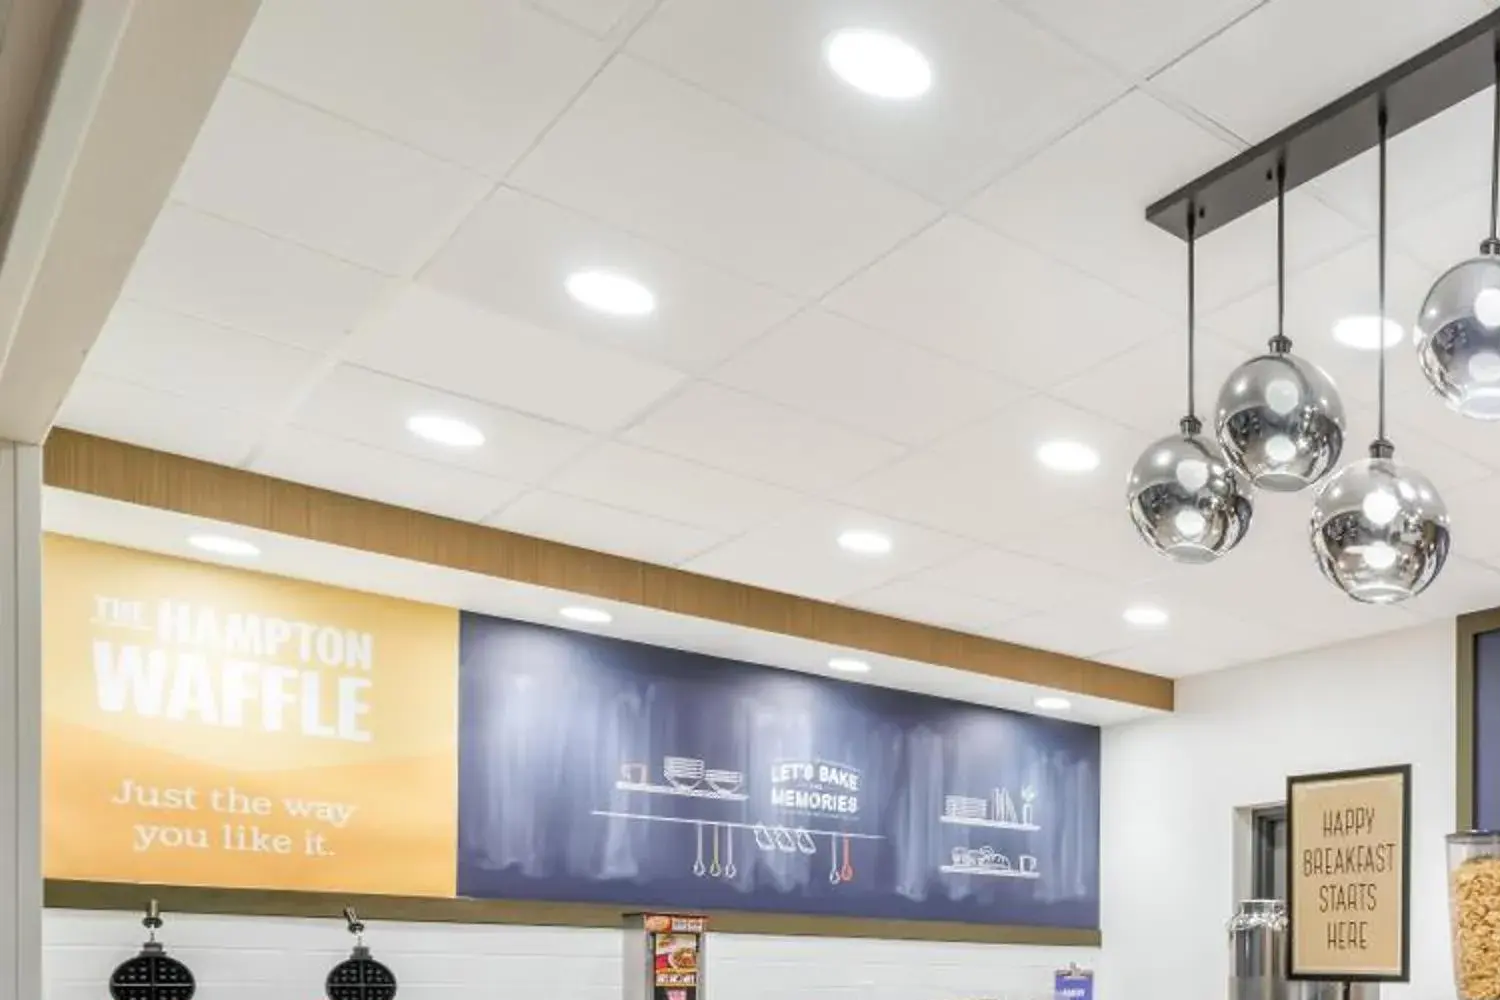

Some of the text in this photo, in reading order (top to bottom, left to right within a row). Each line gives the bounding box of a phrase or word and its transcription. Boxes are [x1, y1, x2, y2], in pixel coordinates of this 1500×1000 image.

[94, 596, 374, 671] THE HAMPTON
[92, 637, 374, 742] WAFFLE
[819, 764, 861, 791] BAKE
[111, 778, 358, 828] Just the way
[771, 786, 859, 814] MEMORIES
[1322, 807, 1375, 839] HAPPY
[133, 823, 336, 857] you like it.
[1302, 843, 1396, 878] BREAKFAST
[1318, 883, 1378, 914] STARTS
[1327, 920, 1369, 951] HERE
